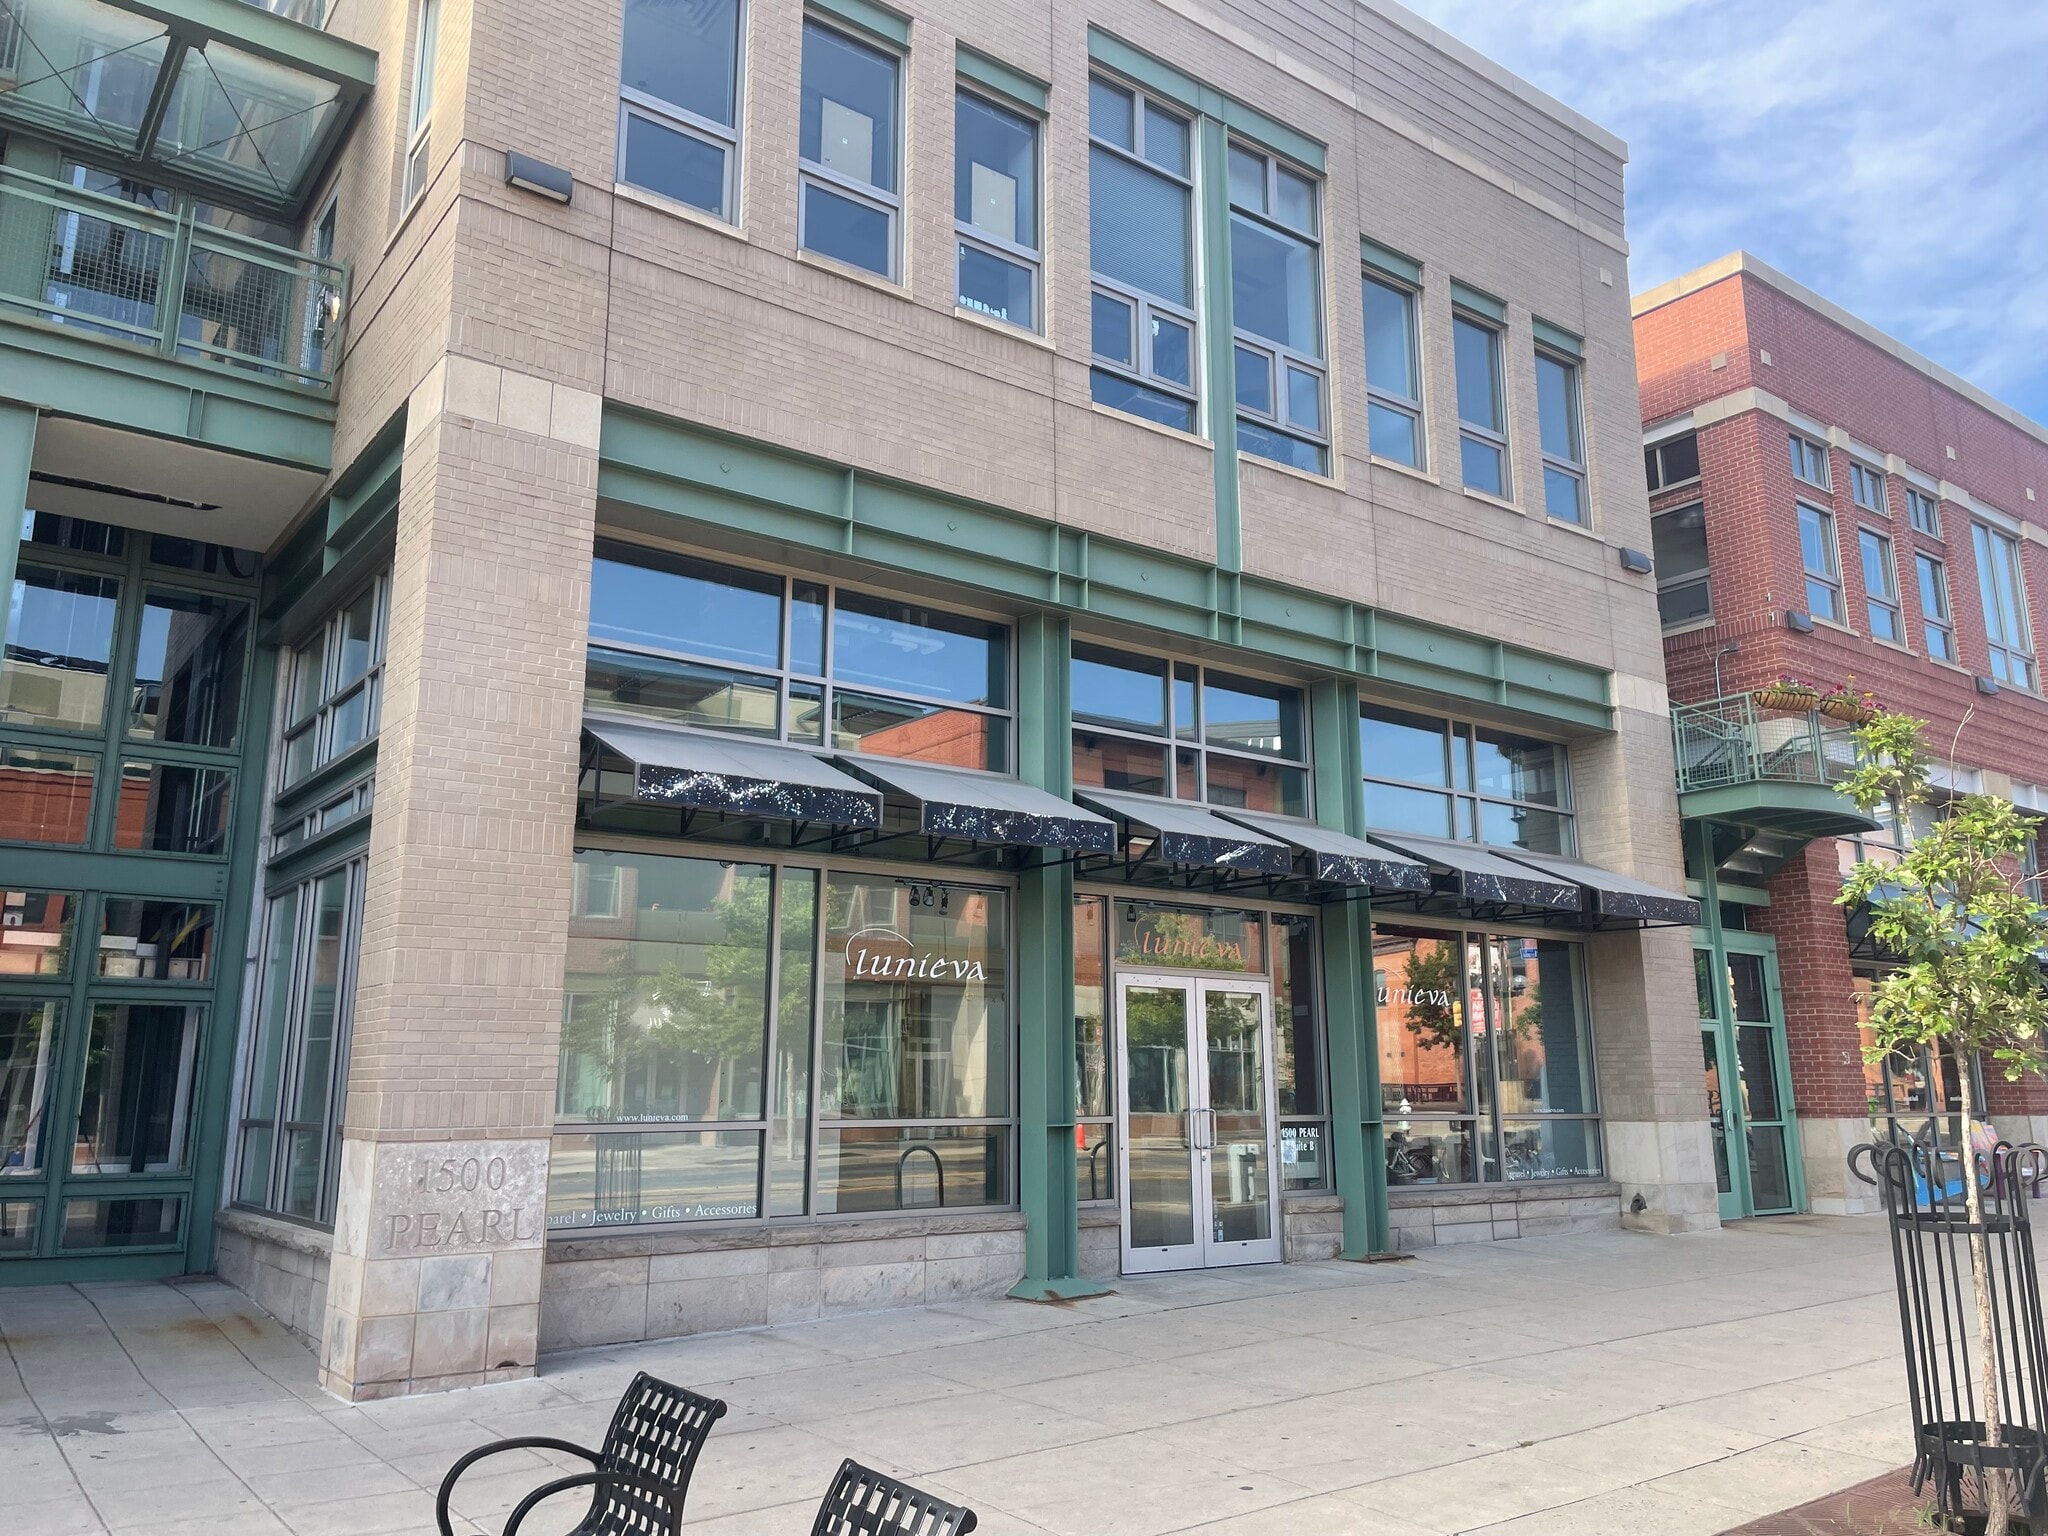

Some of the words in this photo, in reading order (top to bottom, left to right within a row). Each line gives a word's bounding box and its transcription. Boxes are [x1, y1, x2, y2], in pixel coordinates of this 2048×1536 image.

[1143, 931, 1242, 960] lunieva
[856, 948, 987, 981] lunieva
[1377, 985, 1450, 1006] unieva
[616, 1113, 689, 1122] www.lunieva.com
[1281, 1127, 1297, 1138] 1500
[1299, 1127, 1320, 1138] PEARL
[1309, 1140, 1315, 1151] B
[418, 1157, 507, 1194] 1500
[589, 1208, 637, 1226] Jewelry
[651, 1206, 681, 1219] Gifts
[694, 1203, 758, 1217] Accessories
[385, 1207, 536, 1250] PEARL
